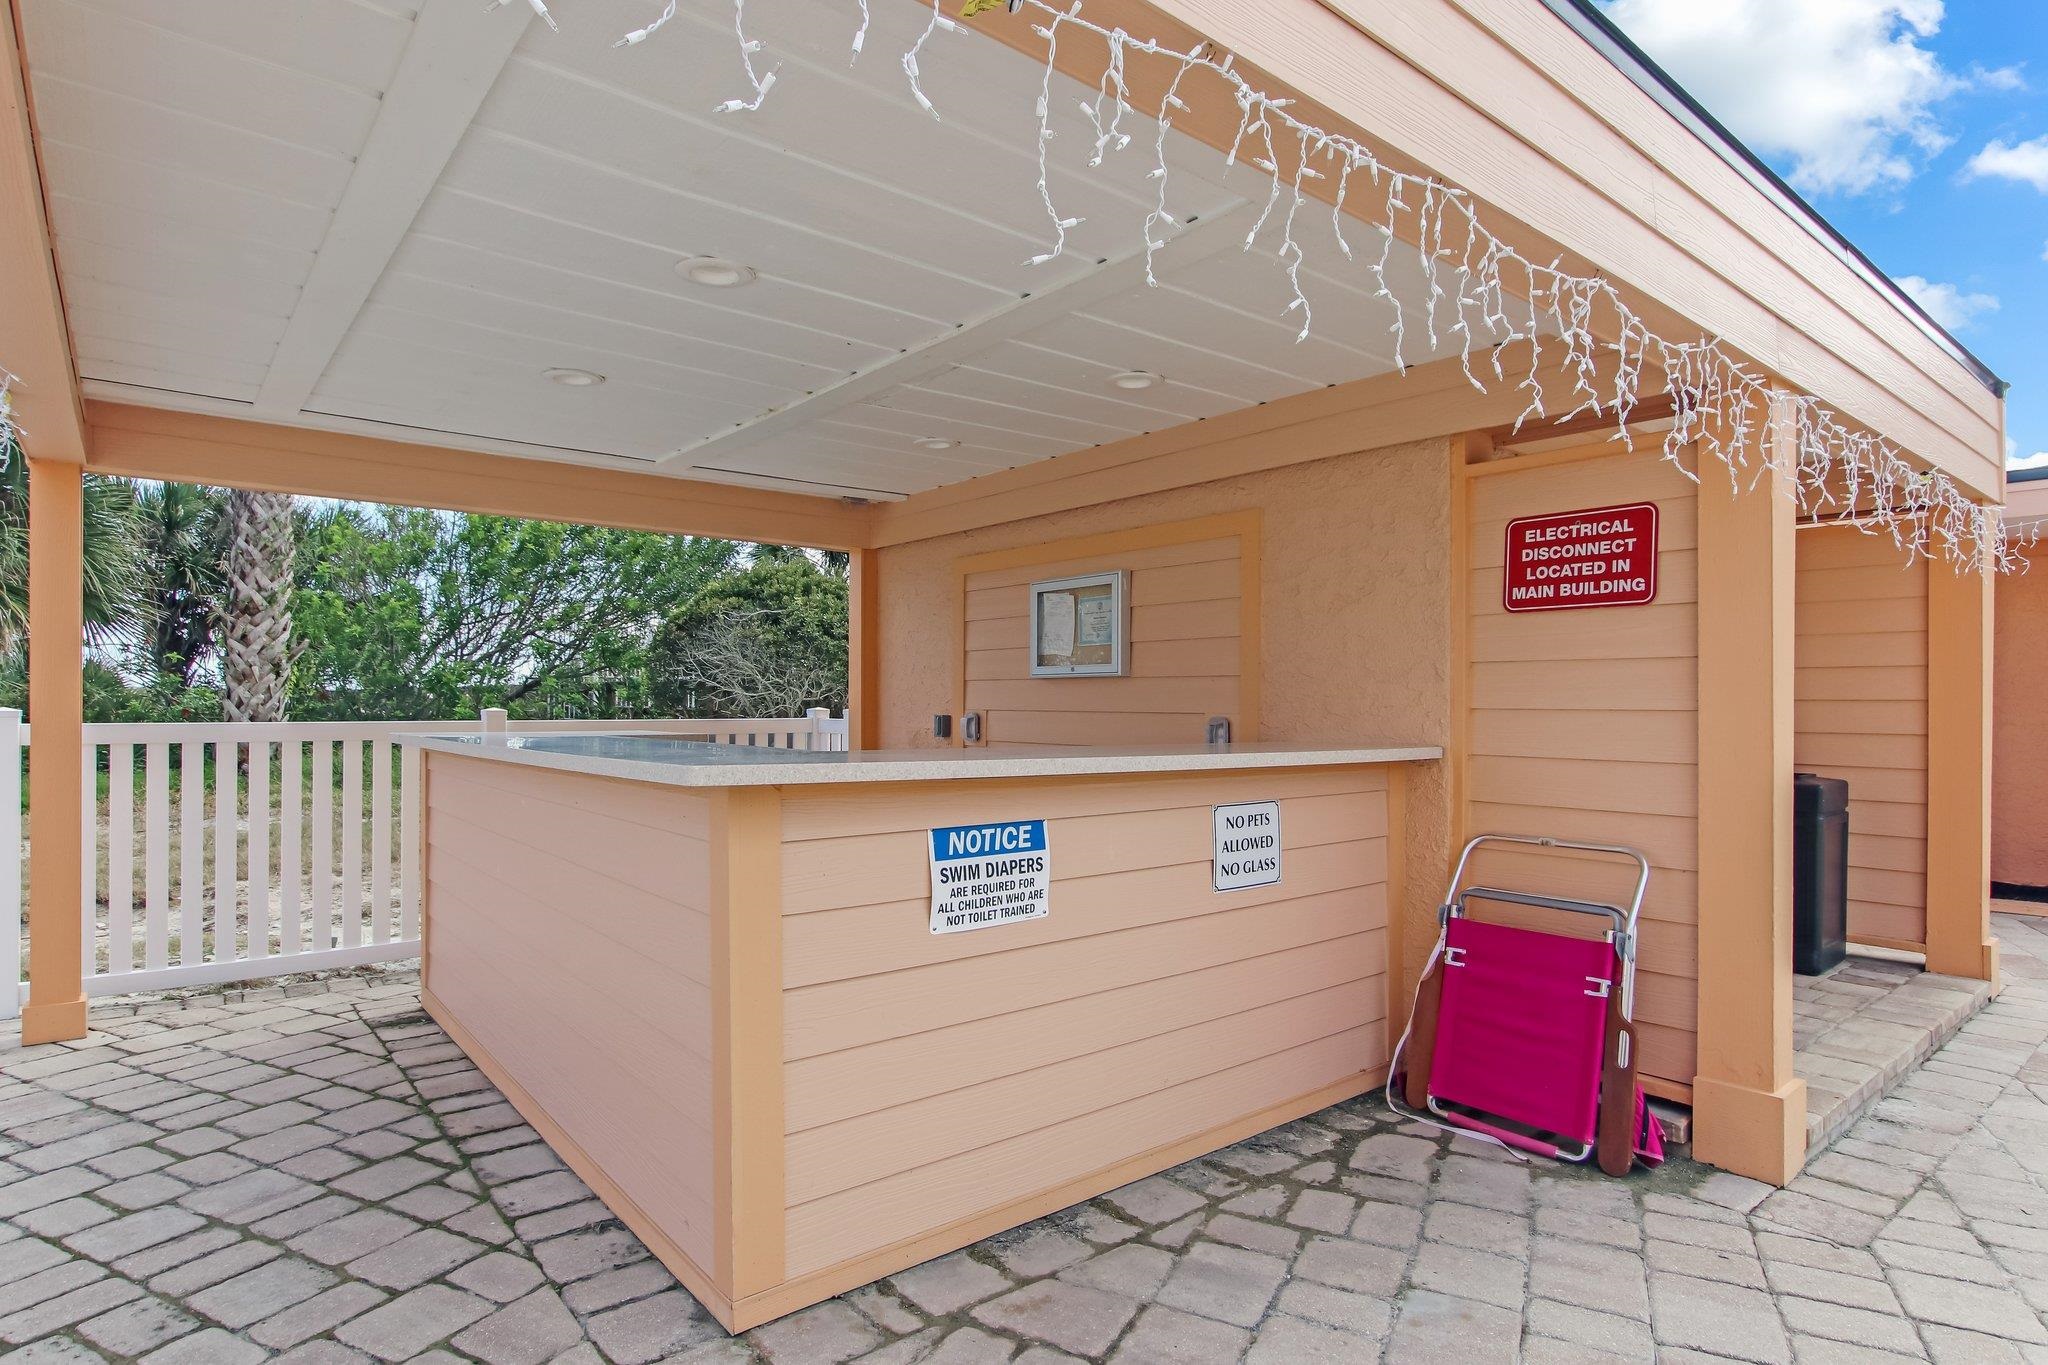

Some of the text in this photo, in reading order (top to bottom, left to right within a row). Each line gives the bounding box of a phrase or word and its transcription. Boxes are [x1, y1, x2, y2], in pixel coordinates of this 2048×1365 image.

[1525, 519, 1634, 543] ELECTRICAL
[1521, 537, 1637, 562] DISCONNECT
[1526, 559, 1630, 580] LOCATED IN
[1512, 577, 1646, 600] MAIN BUILDING
[1226, 812, 1270, 829] NO PETS
[948, 825, 1032, 855] NOTICE
[1221, 835, 1274, 853] ALLOWED
[940, 856, 1044, 884] SWIM DIAPERS
[1221, 857, 1276, 877] NO GLASS
[950, 877, 1035, 899] ARE REQUIRED FOR
[937, 889, 1044, 914] ALL CHILDREN WHO ARE
[946, 903, 1036, 927] NOT TOILET TRAINED
